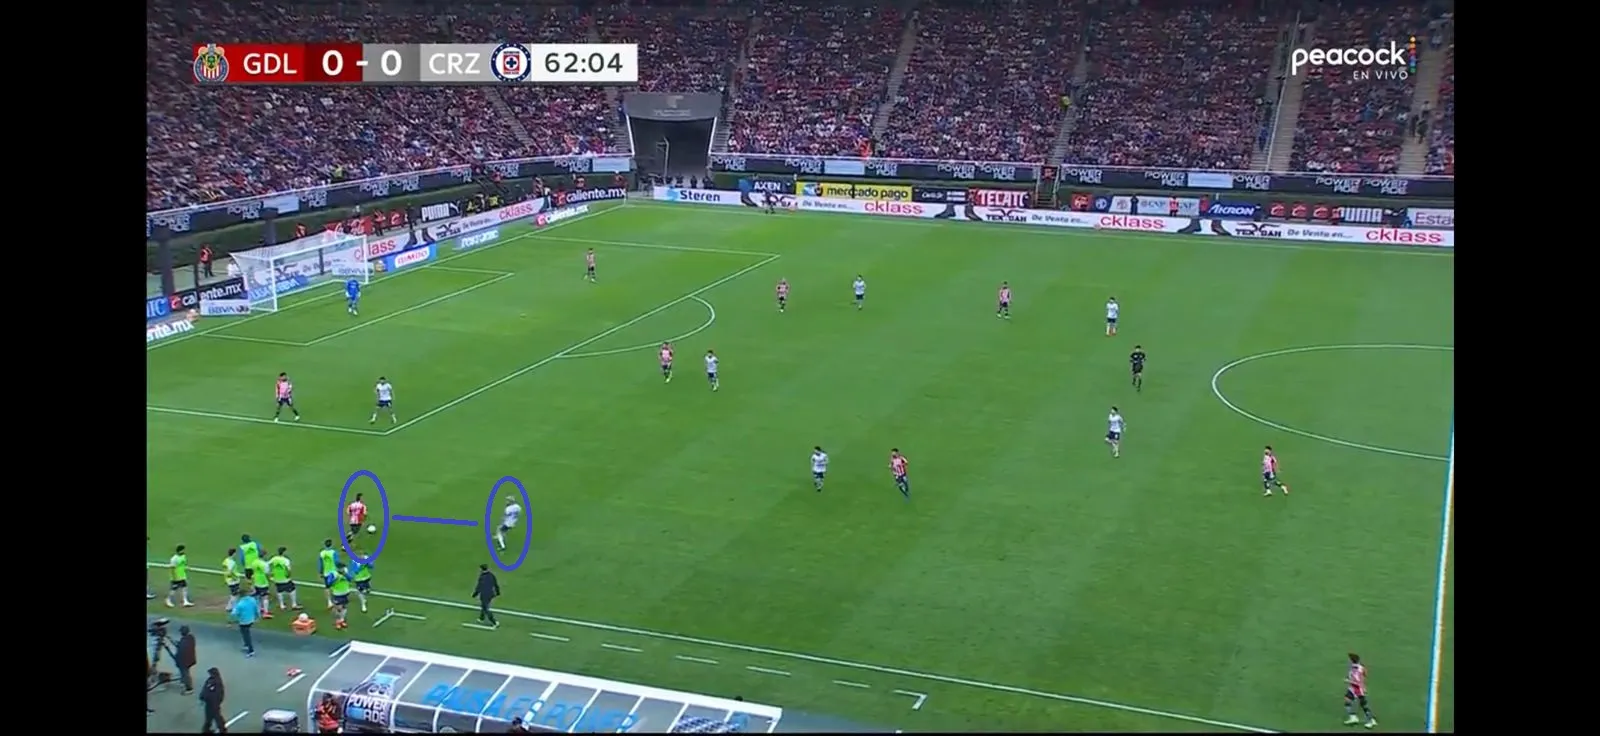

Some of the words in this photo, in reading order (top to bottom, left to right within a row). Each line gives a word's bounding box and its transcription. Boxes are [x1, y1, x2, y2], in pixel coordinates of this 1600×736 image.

[754, 181, 781, 191] AXEN
[827, 185, 879, 199] mercado
[880, 188, 909, 201] pago
[566, 187, 626, 203] caliente.mx
[680, 190, 720, 202] Steren
[422, 203, 450, 221] PUMA
[500, 202, 533, 220] cklass
[865, 200, 924, 215] cklass
[1209, 203, 1255, 216] AKRON
[1101, 215, 1164, 229] cklass
[1415, 211, 1454, 225] Esta
[1366, 228, 1441, 244] cklass
[182, 283, 242, 306] calente.mx
[347, 694, 388, 713] POWER
